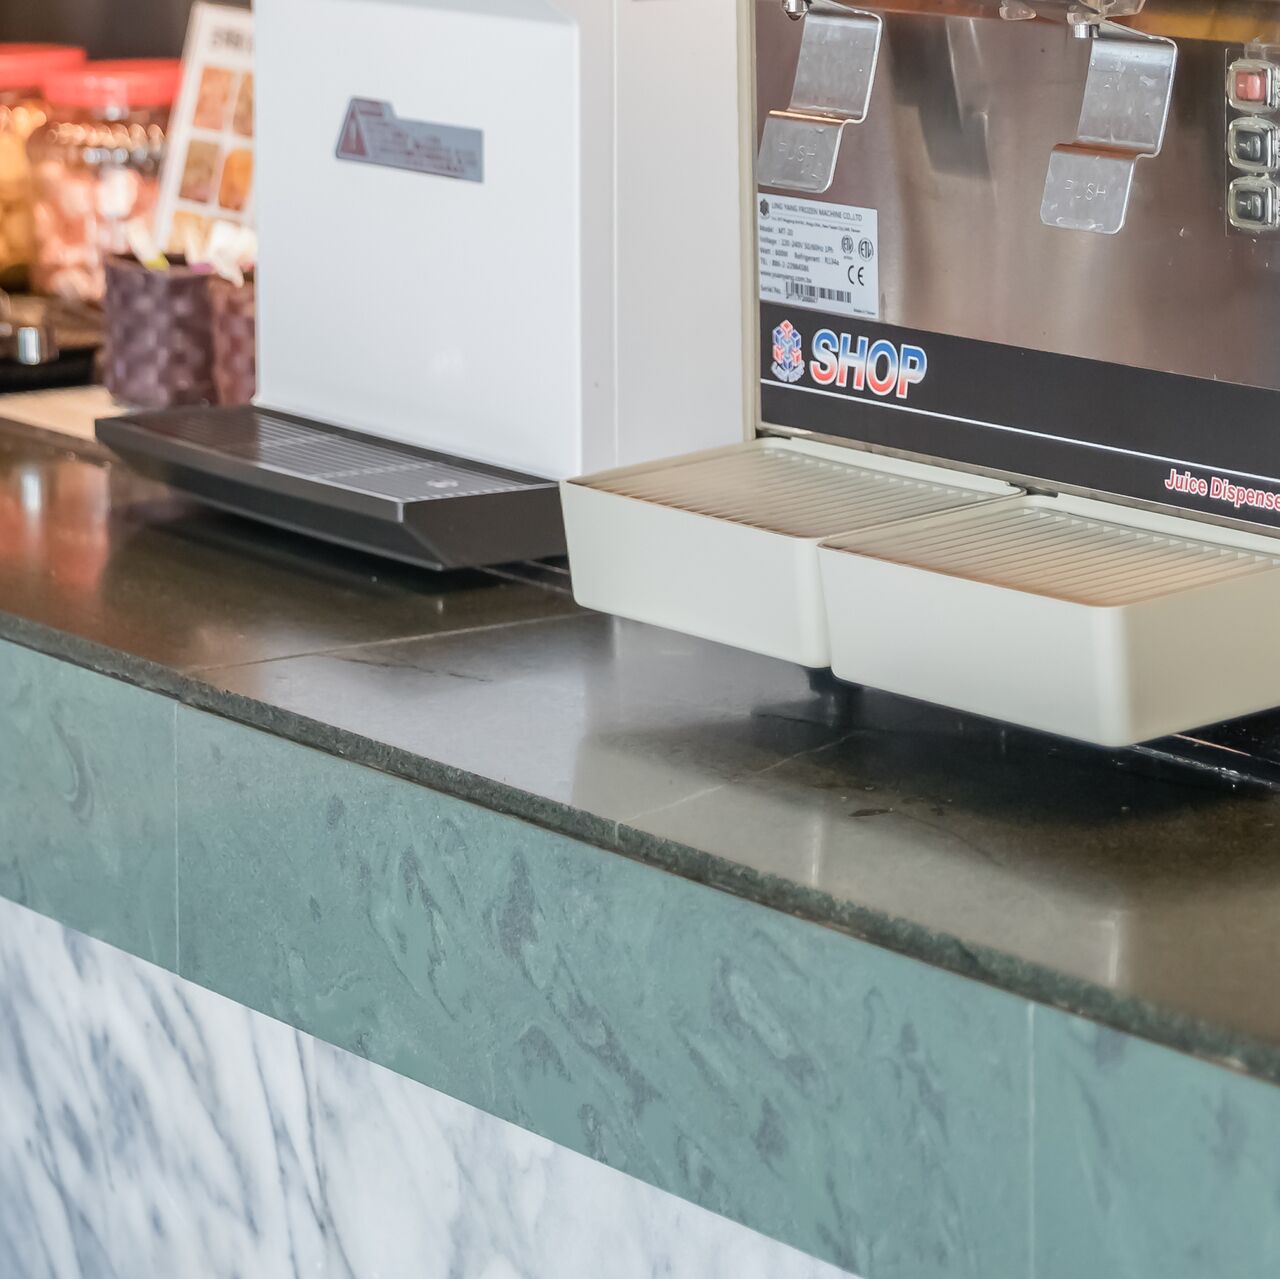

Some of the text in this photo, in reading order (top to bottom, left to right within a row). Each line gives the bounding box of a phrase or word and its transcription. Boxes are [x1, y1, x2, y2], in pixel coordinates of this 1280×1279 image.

[1063, 179, 1107, 200] PUSH
[819, 208, 842, 219] MACHINE
[847, 265, 865, 287] CE
[809, 328, 928, 400] SHOP
[1164, 468, 1208, 496] Juice
